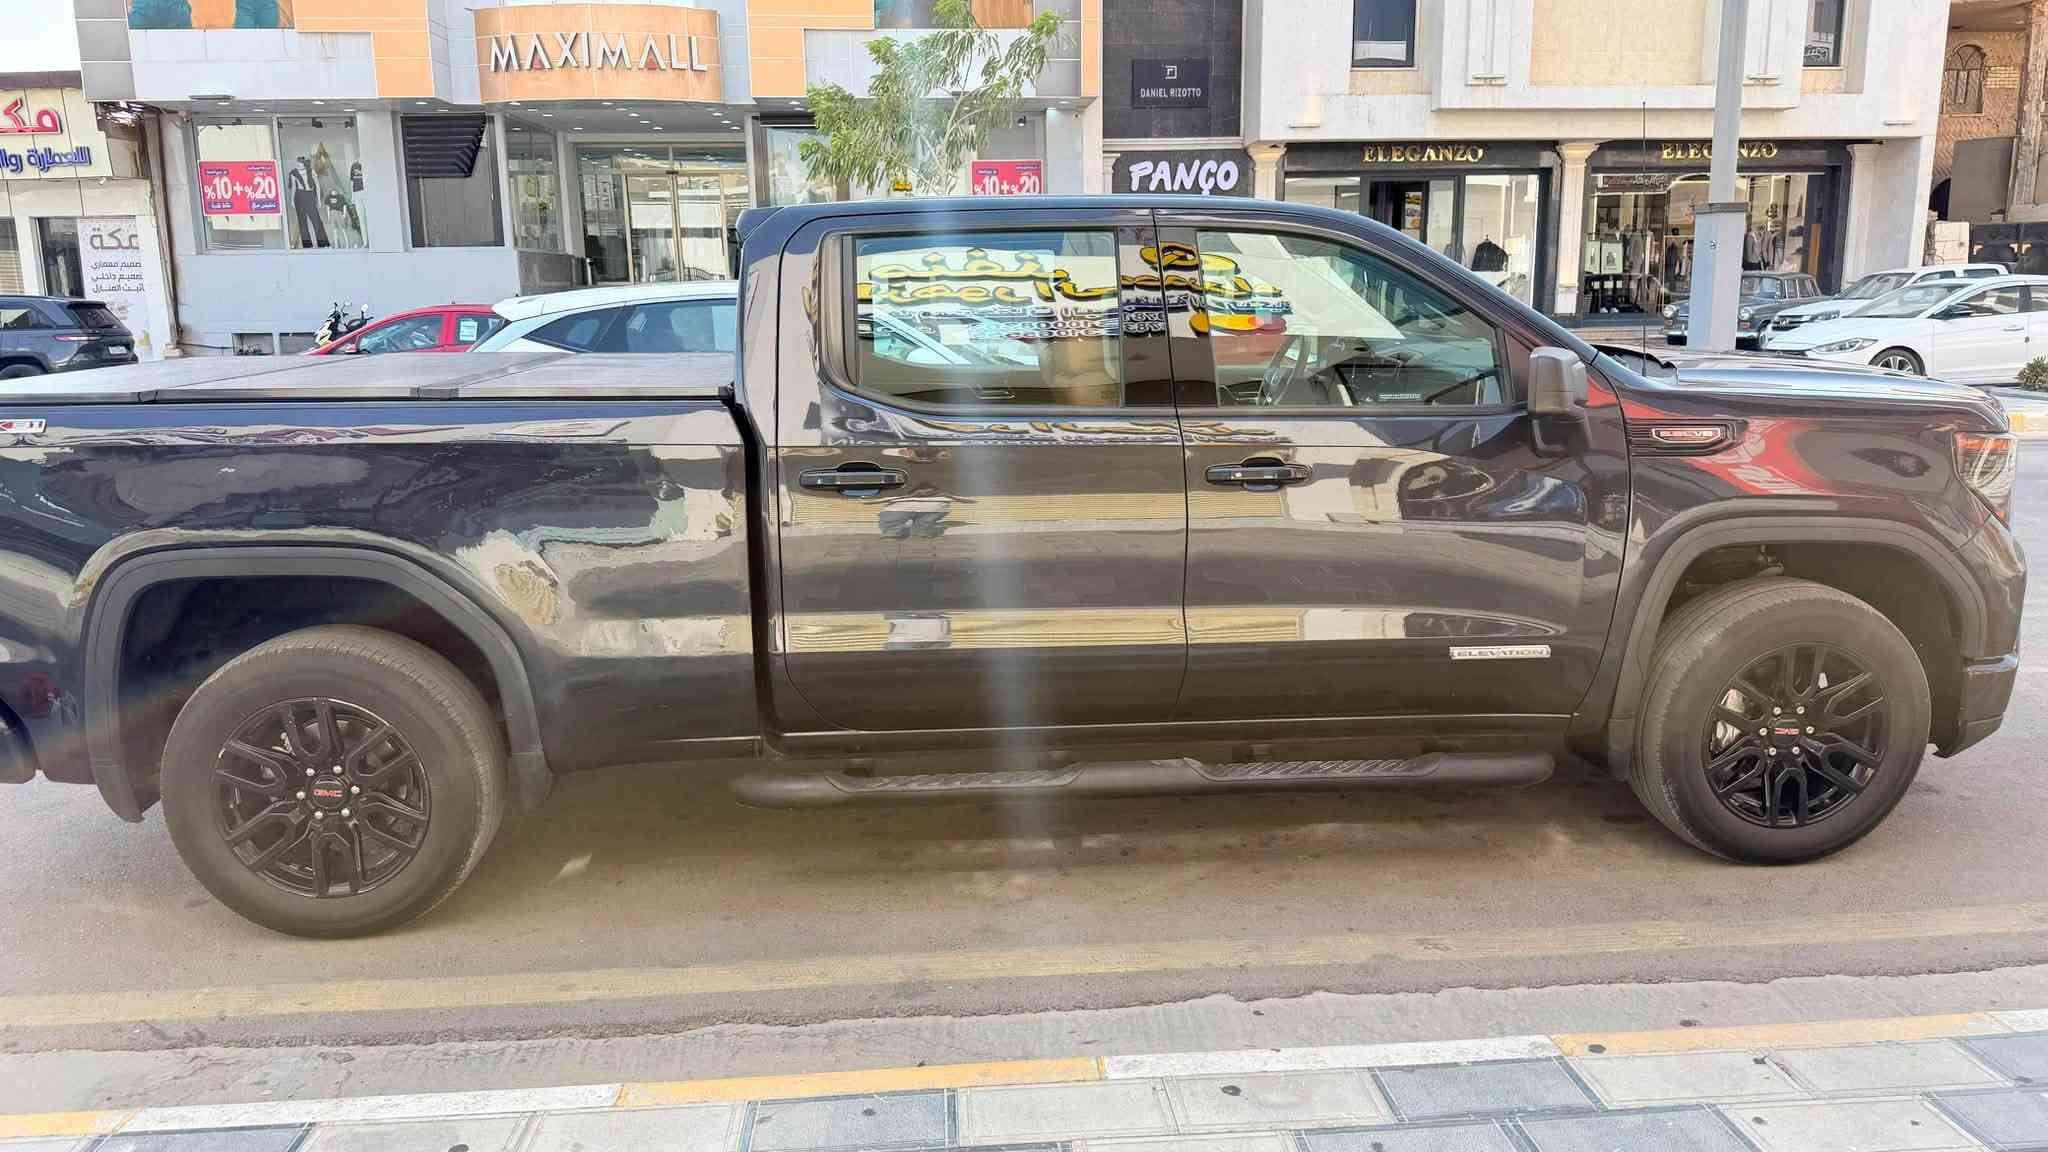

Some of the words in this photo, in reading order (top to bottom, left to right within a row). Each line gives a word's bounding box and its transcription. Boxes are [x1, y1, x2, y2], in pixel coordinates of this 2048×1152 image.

[489, 32, 709, 72] MAXIMALL
[1140, 87, 1168, 98] DANIEL
[1169, 87, 1202, 98] RIZOTTO
[0, 98, 62, 134] مك
[1363, 145, 1485, 162] ELEGANZO
[1661, 143, 1778, 160] ELEGNZO
[1129, 160, 1239, 195] PANÇO
[1453, 646, 1548, 658] ELEVATION
